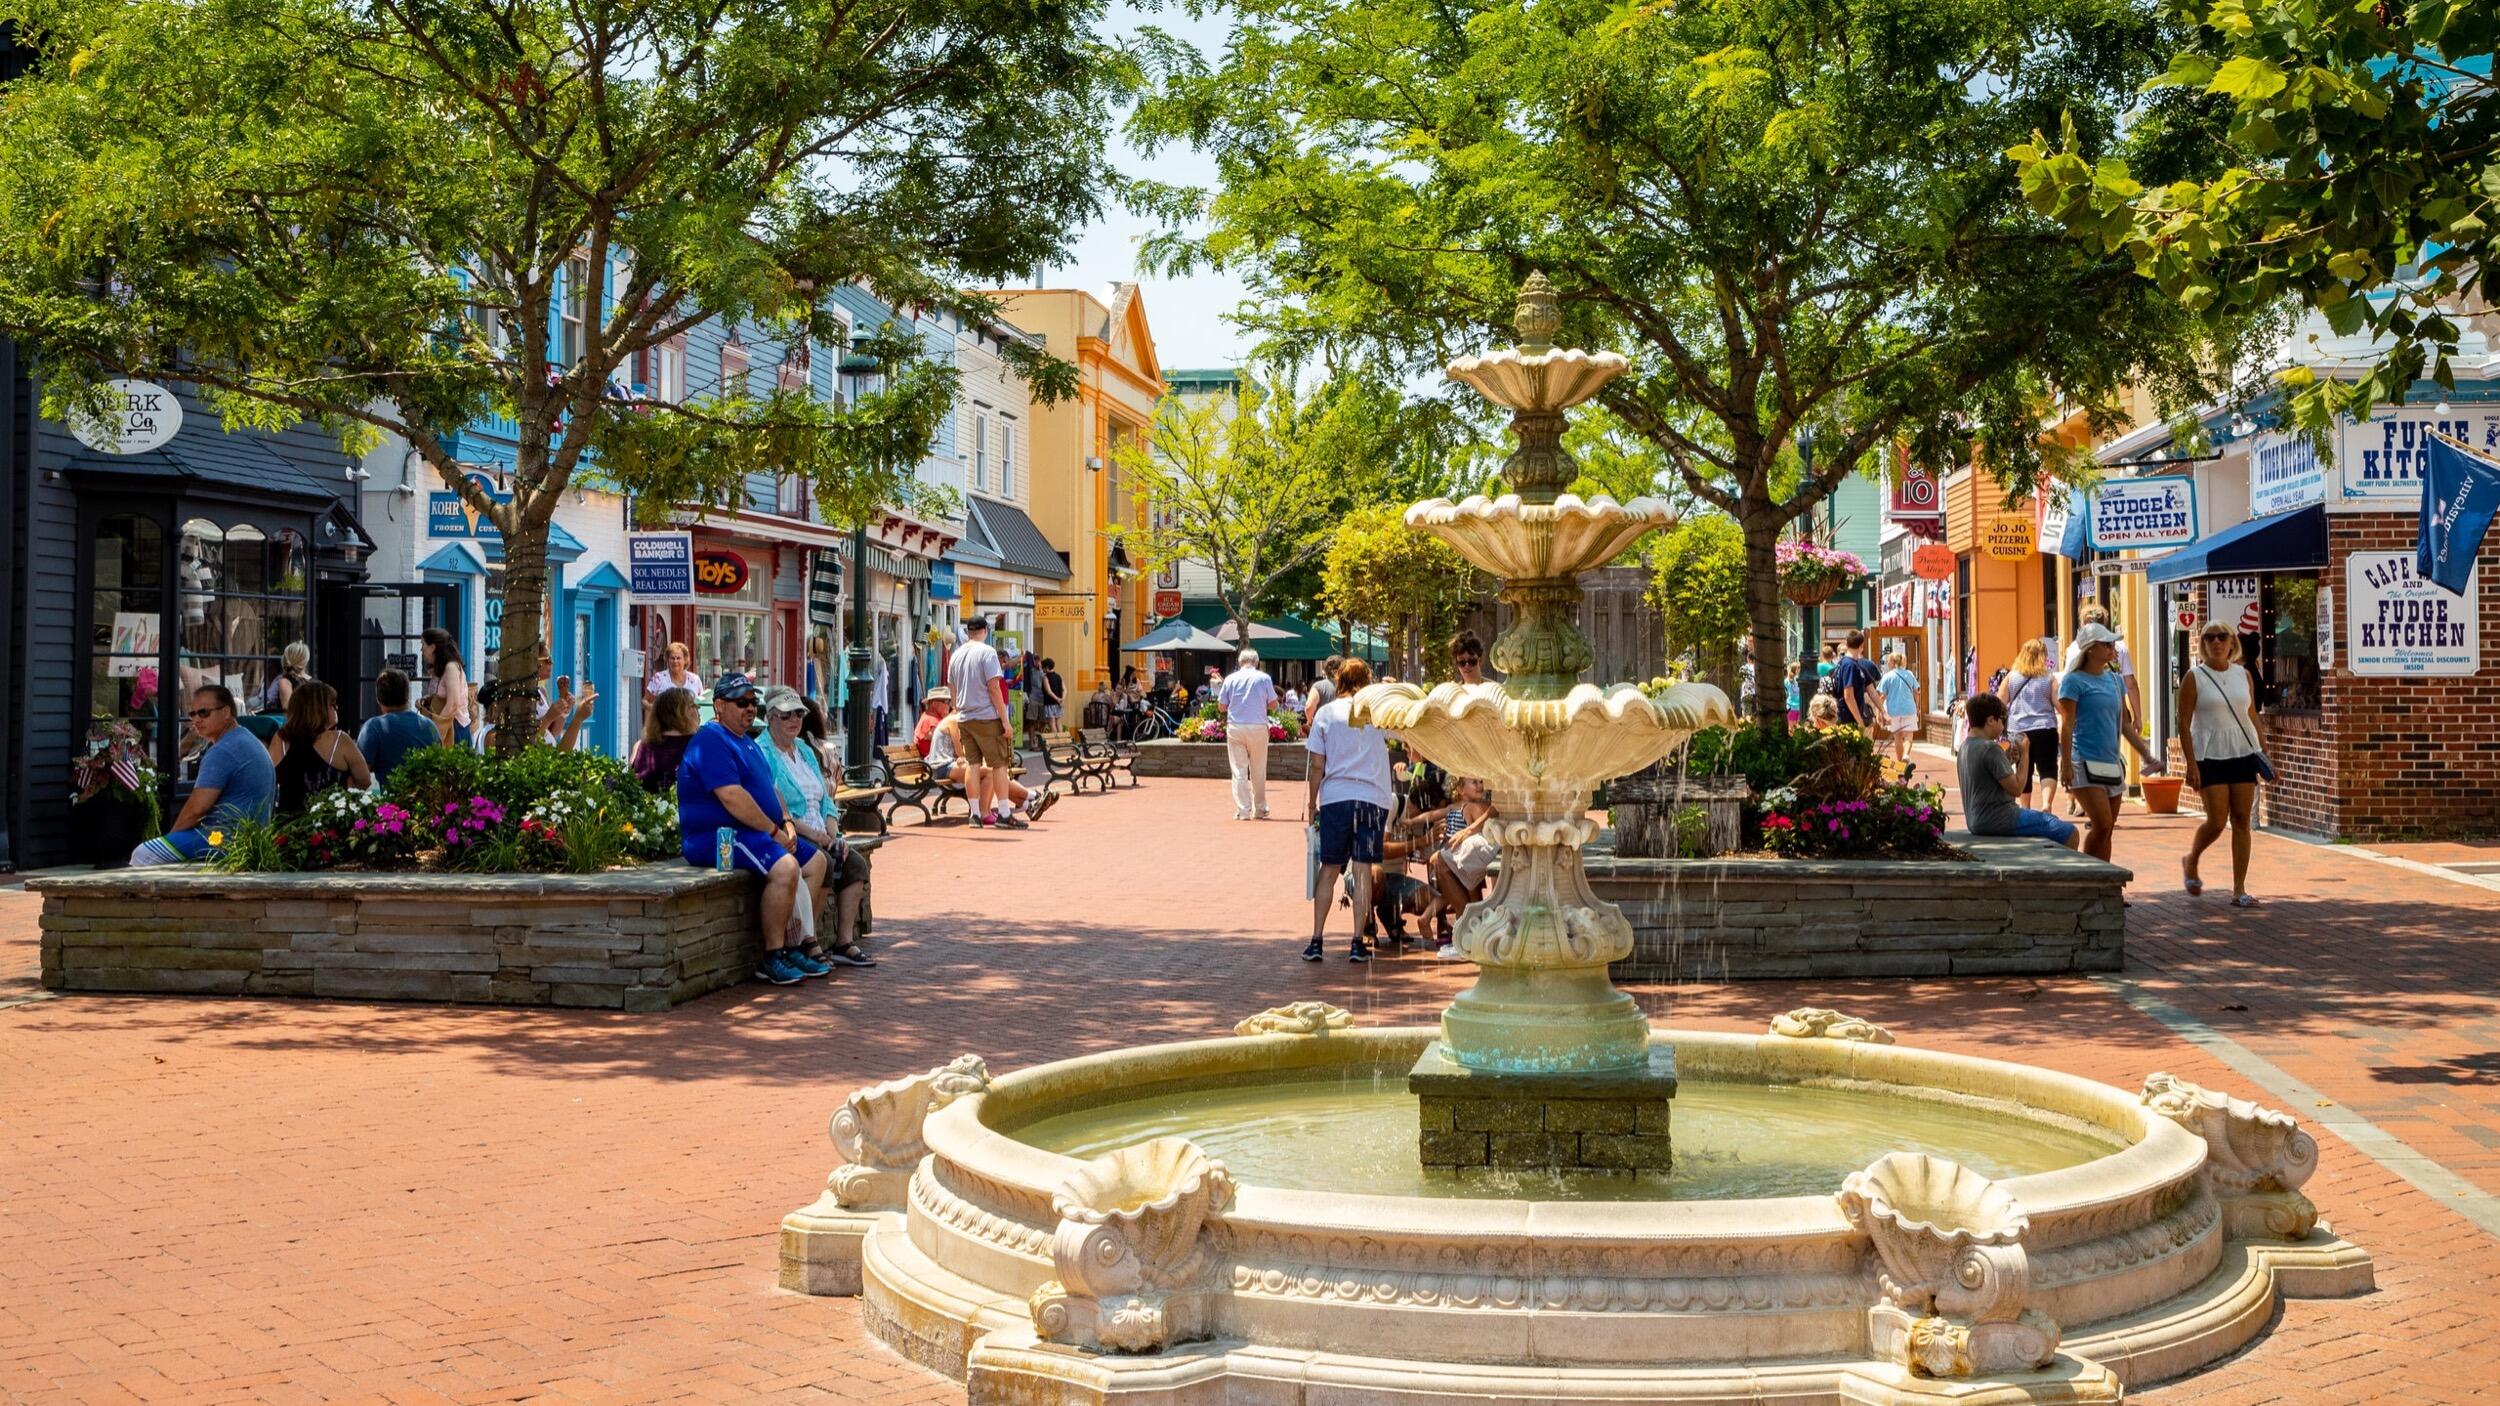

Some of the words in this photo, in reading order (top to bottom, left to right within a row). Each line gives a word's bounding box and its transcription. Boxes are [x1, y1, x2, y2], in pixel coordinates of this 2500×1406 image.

[1903, 480, 1934, 505] 10
[2271, 496, 2284, 508] OPEN
[2292, 489, 2305, 502] YEAR
[431, 501, 459, 516] KOHR
[2100, 497, 2163, 515] FUDGE
[2098, 512, 2187, 532] KITCHEN
[434, 524, 464, 532] FROZEN
[478, 525, 500, 533] CUST
[1993, 524, 2008, 533] JO
[2012, 524, 2026, 533] JO
[1988, 535, 2030, 544] PIZZERIA
[2098, 532, 2131, 541] OPEN
[2134, 531, 2155, 539] ALL
[2158, 528, 2188, 537] YEAR
[633, 541, 684, 550] COLDWELL
[634, 550, 675, 559] BANKER
[1992, 546, 2027, 556] CUISINE
[634, 567, 649, 578] SOL
[651, 567, 687, 578] NEEDLES
[2365, 557, 2410, 589] CAPE
[635, 580, 656, 590] REAL
[659, 580, 687, 590] ESTATE
[2216, 579, 2256, 594] KITC
[2402, 581, 2423, 589] AND
[2387, 591, 2402, 599] The
[2404, 589, 2438, 597] Original
[1037, 606, 1049, 616] JUST
[1065, 606, 1085, 616] LAUGHS
[2178, 603, 2196, 611] AED
[2378, 599, 2448, 622] FUDGE
[2362, 623, 2465, 647] KITCHEN
